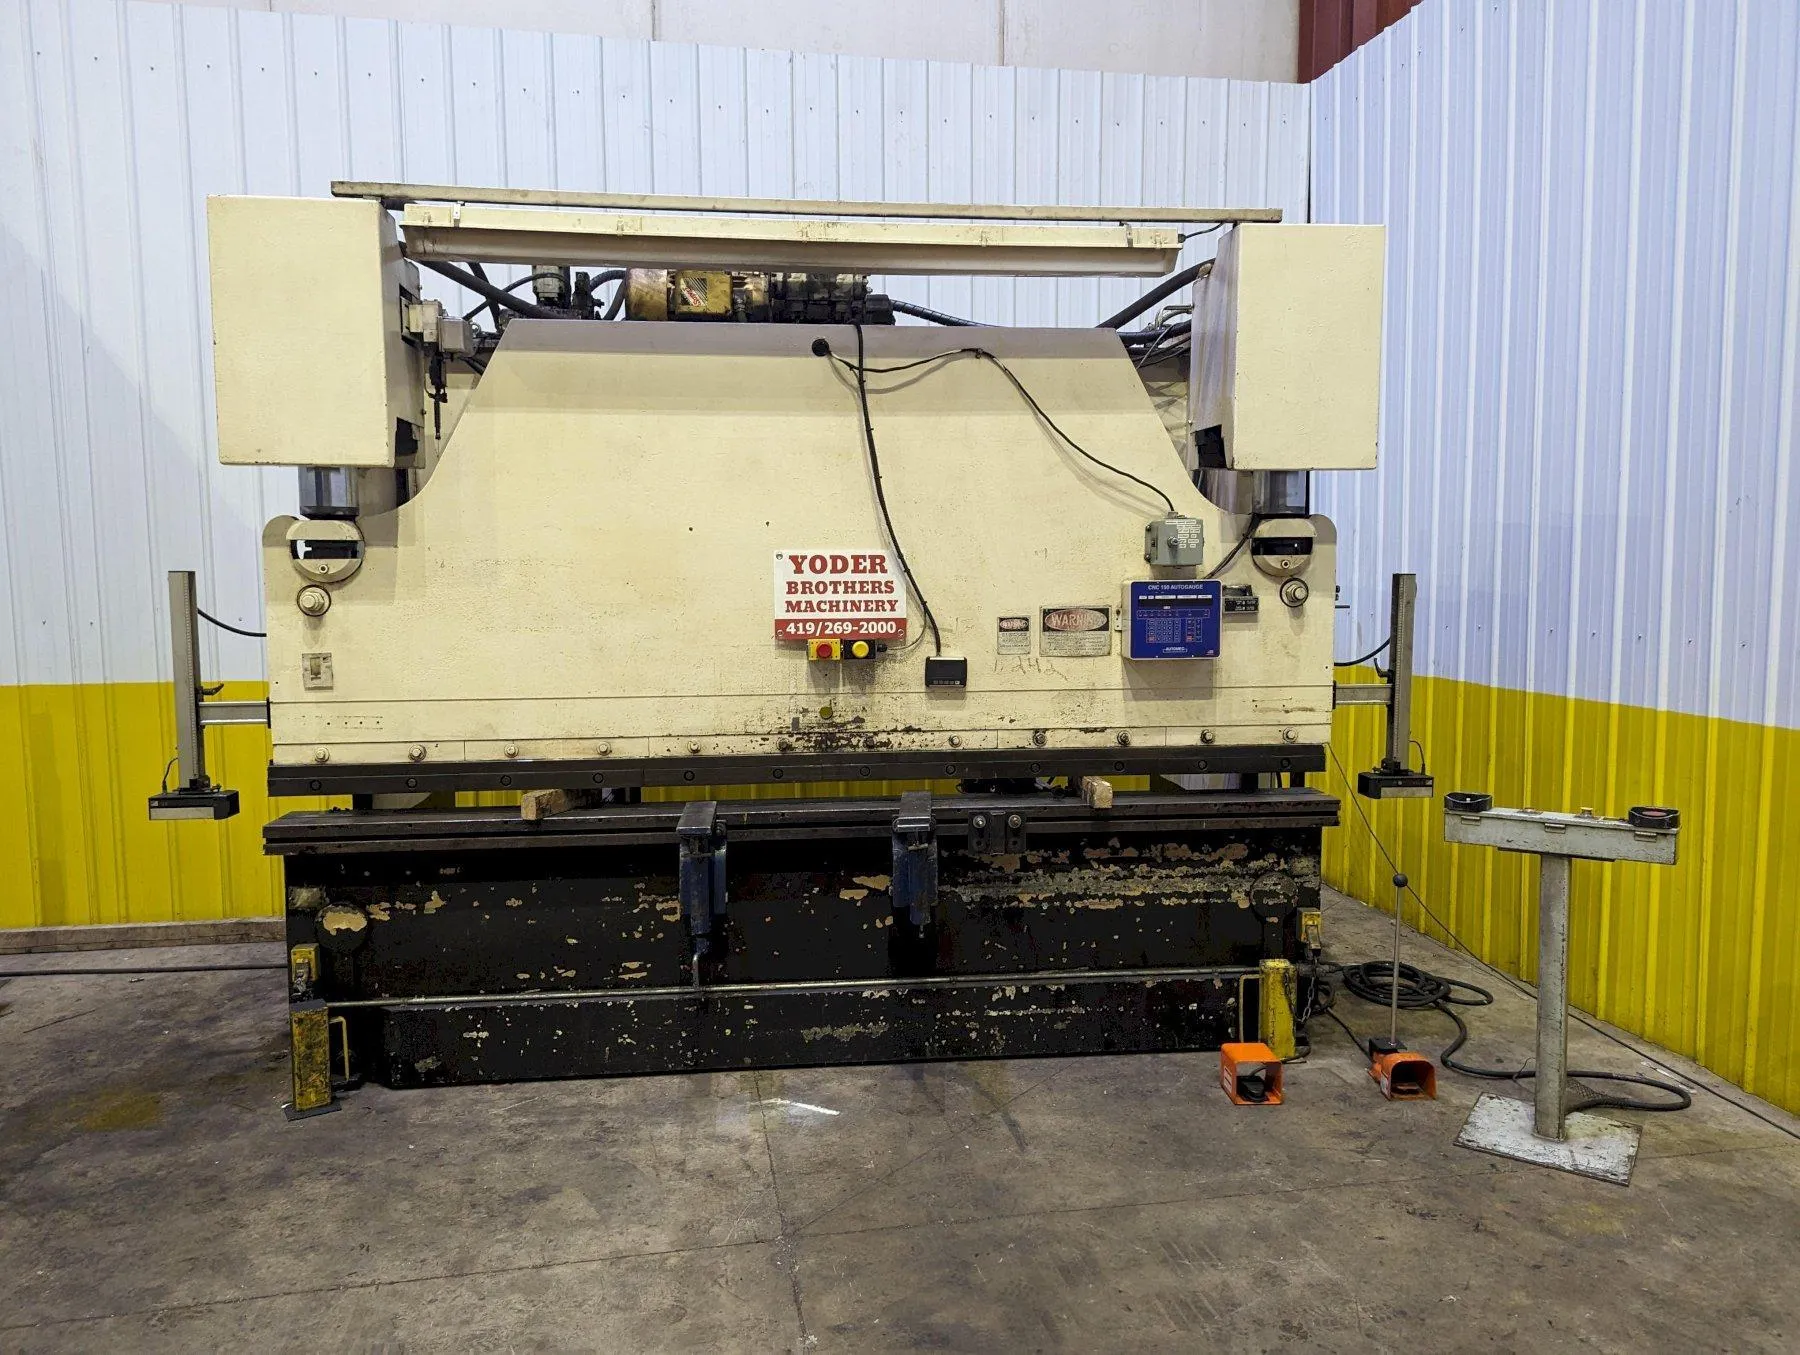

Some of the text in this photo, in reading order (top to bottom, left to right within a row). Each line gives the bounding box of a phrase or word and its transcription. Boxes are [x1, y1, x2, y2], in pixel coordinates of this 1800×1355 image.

[788, 554, 888, 574] YODER
[785, 580, 895, 595] BROTHERS
[785, 599, 898, 613] MACHINERY
[786, 621, 896, 636] 419/269-2000
